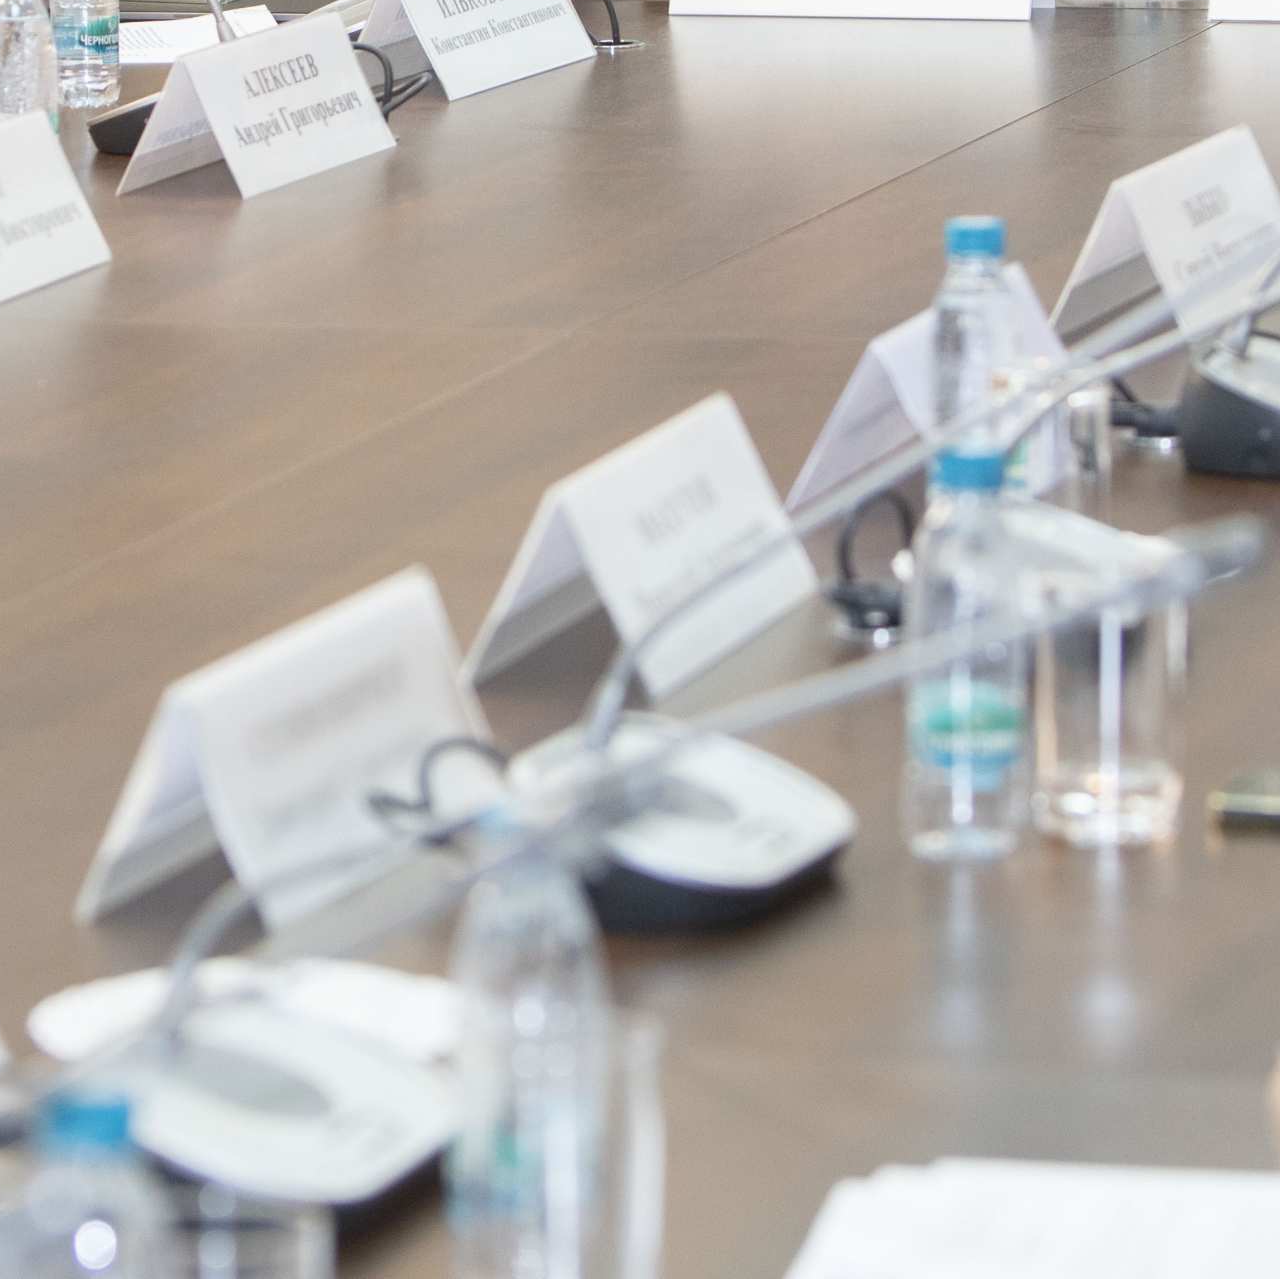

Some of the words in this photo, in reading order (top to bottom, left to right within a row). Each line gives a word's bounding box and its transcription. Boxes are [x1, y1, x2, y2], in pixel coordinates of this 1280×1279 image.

[430, 26, 491, 56] Константин
[487, 3, 567, 37] Константинович
[242, 53, 320, 99] АЛЕКСЕЕВ
[233, 111, 284, 148] Андрей
[277, 90, 363, 136] Григорьевич
